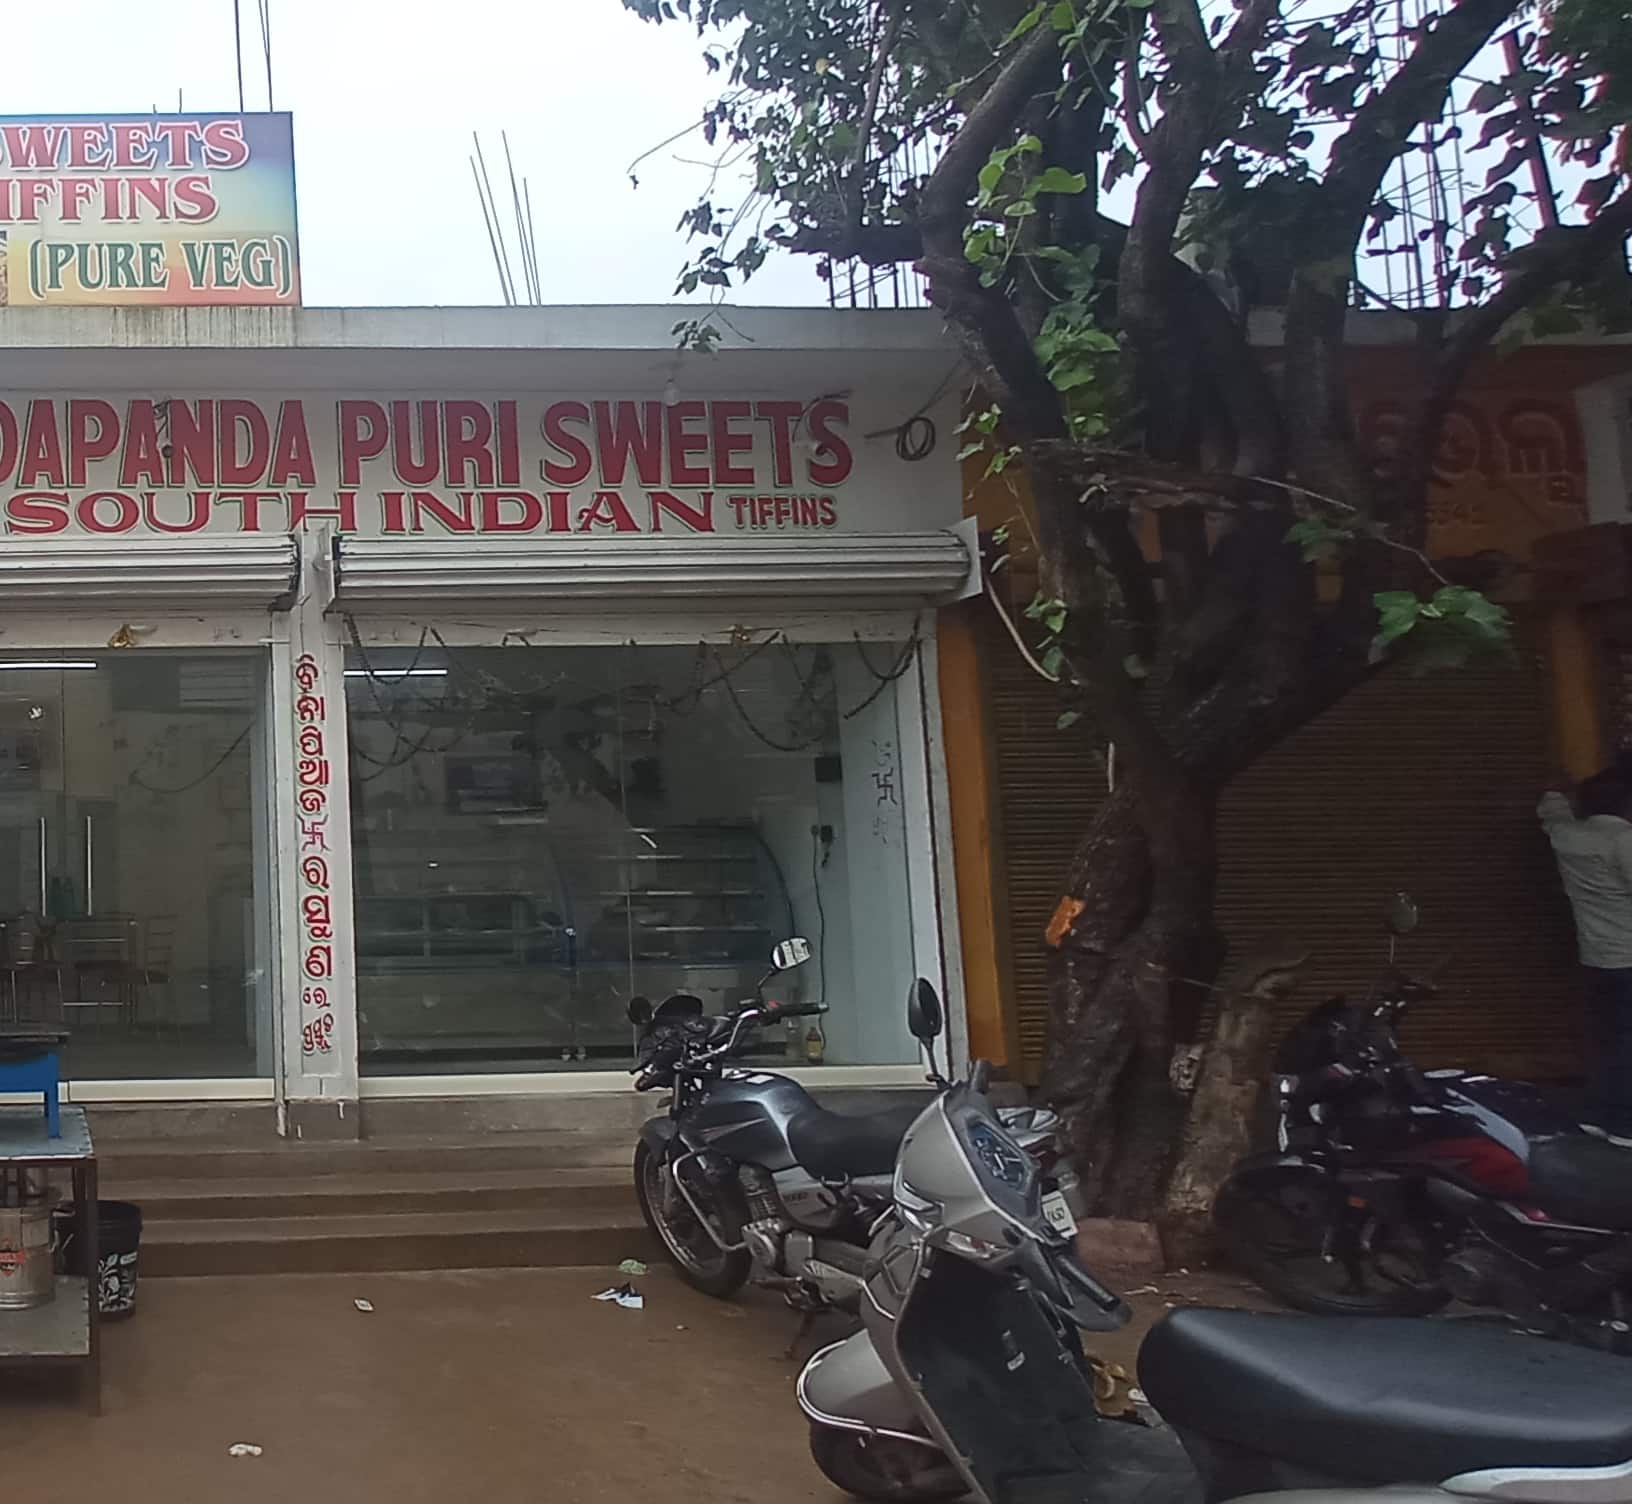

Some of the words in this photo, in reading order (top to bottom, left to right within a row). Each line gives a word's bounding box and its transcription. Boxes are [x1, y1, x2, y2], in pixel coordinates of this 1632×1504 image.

[29, 238, 169, 298] (PURE
[180, 235, 293, 297] VEG)
[338, 399, 520, 487] PURI
[542, 399, 854, 487] SWEETS
[5, 490, 358, 536] SOUTH
[381, 491, 715, 535] INDIAN
[727, 495, 840, 530] TIFFINS
